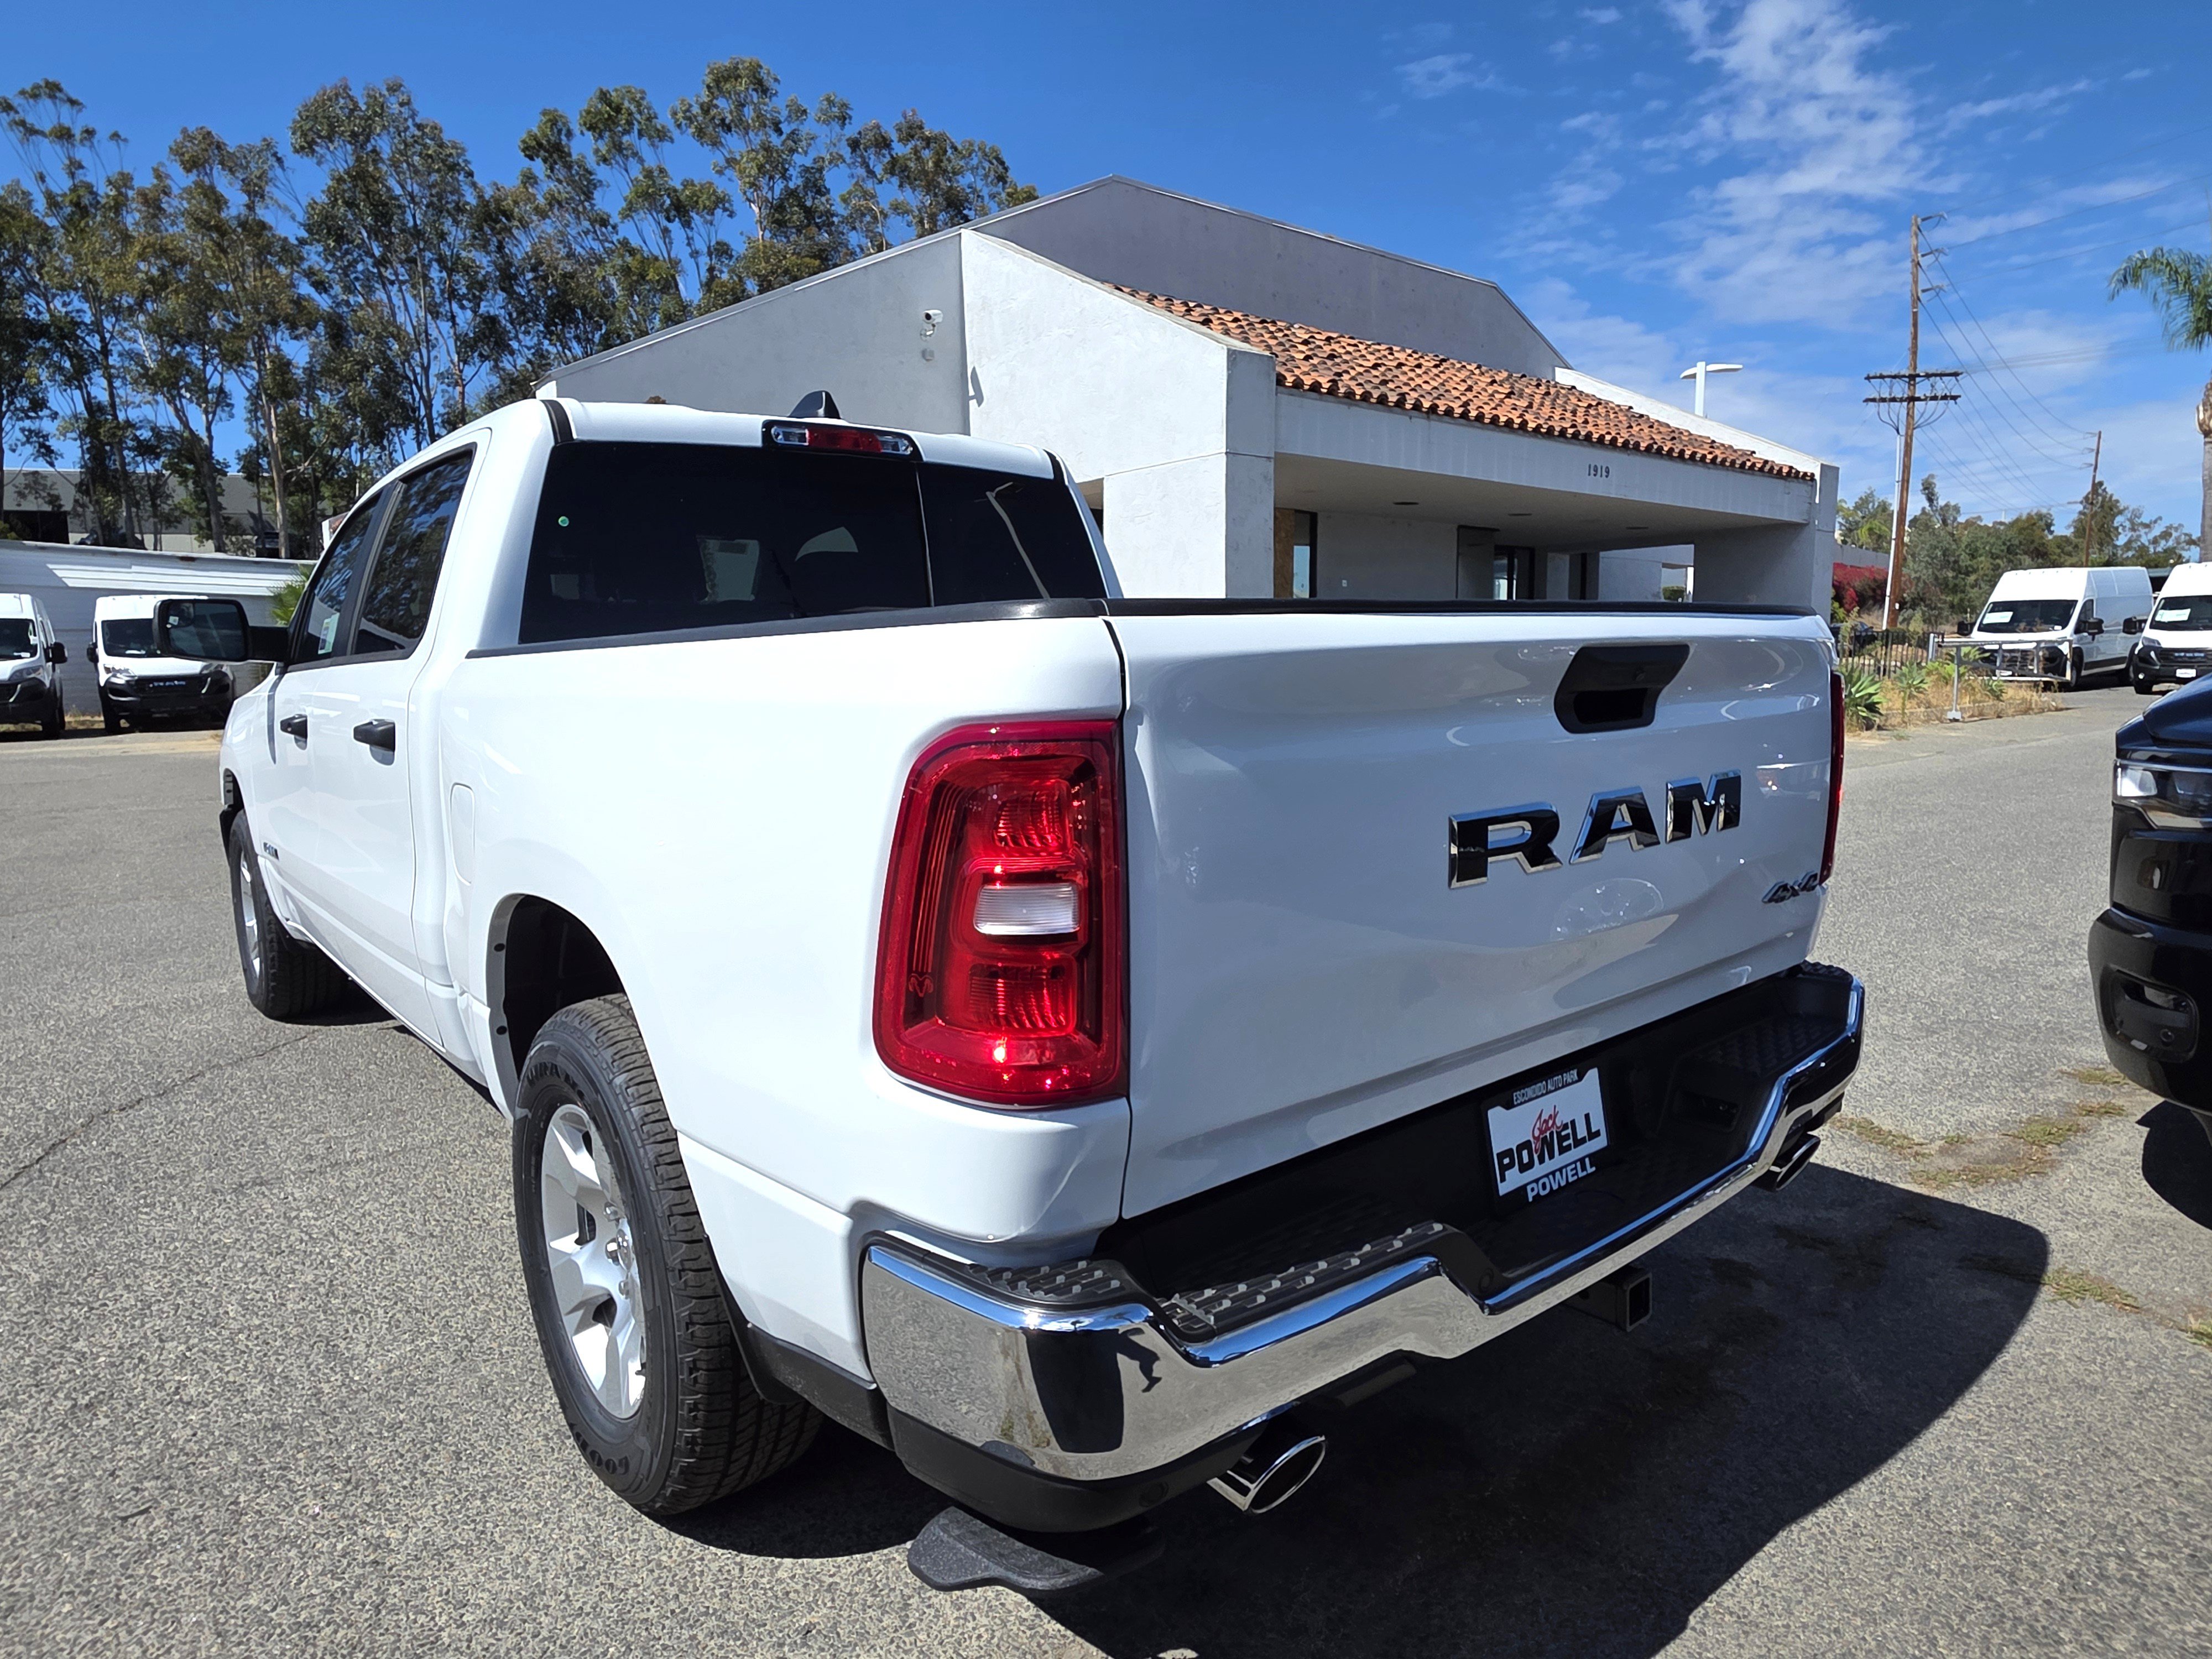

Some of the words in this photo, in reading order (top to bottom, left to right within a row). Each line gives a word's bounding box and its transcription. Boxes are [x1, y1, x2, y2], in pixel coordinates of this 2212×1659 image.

[1588, 463, 1610, 478] 1919
[1448, 769, 1742, 889] RAM
[1513, 1081, 1547, 1105] ESCONDIDO
[1547, 1074, 1563, 1092] AUTO
[1563, 1068, 1578, 1086] PARK
[1496, 1112, 1601, 1183] POWELL
[1532, 1104, 1563, 1155] Jack
[1526, 1157, 1597, 1202] POWELL
